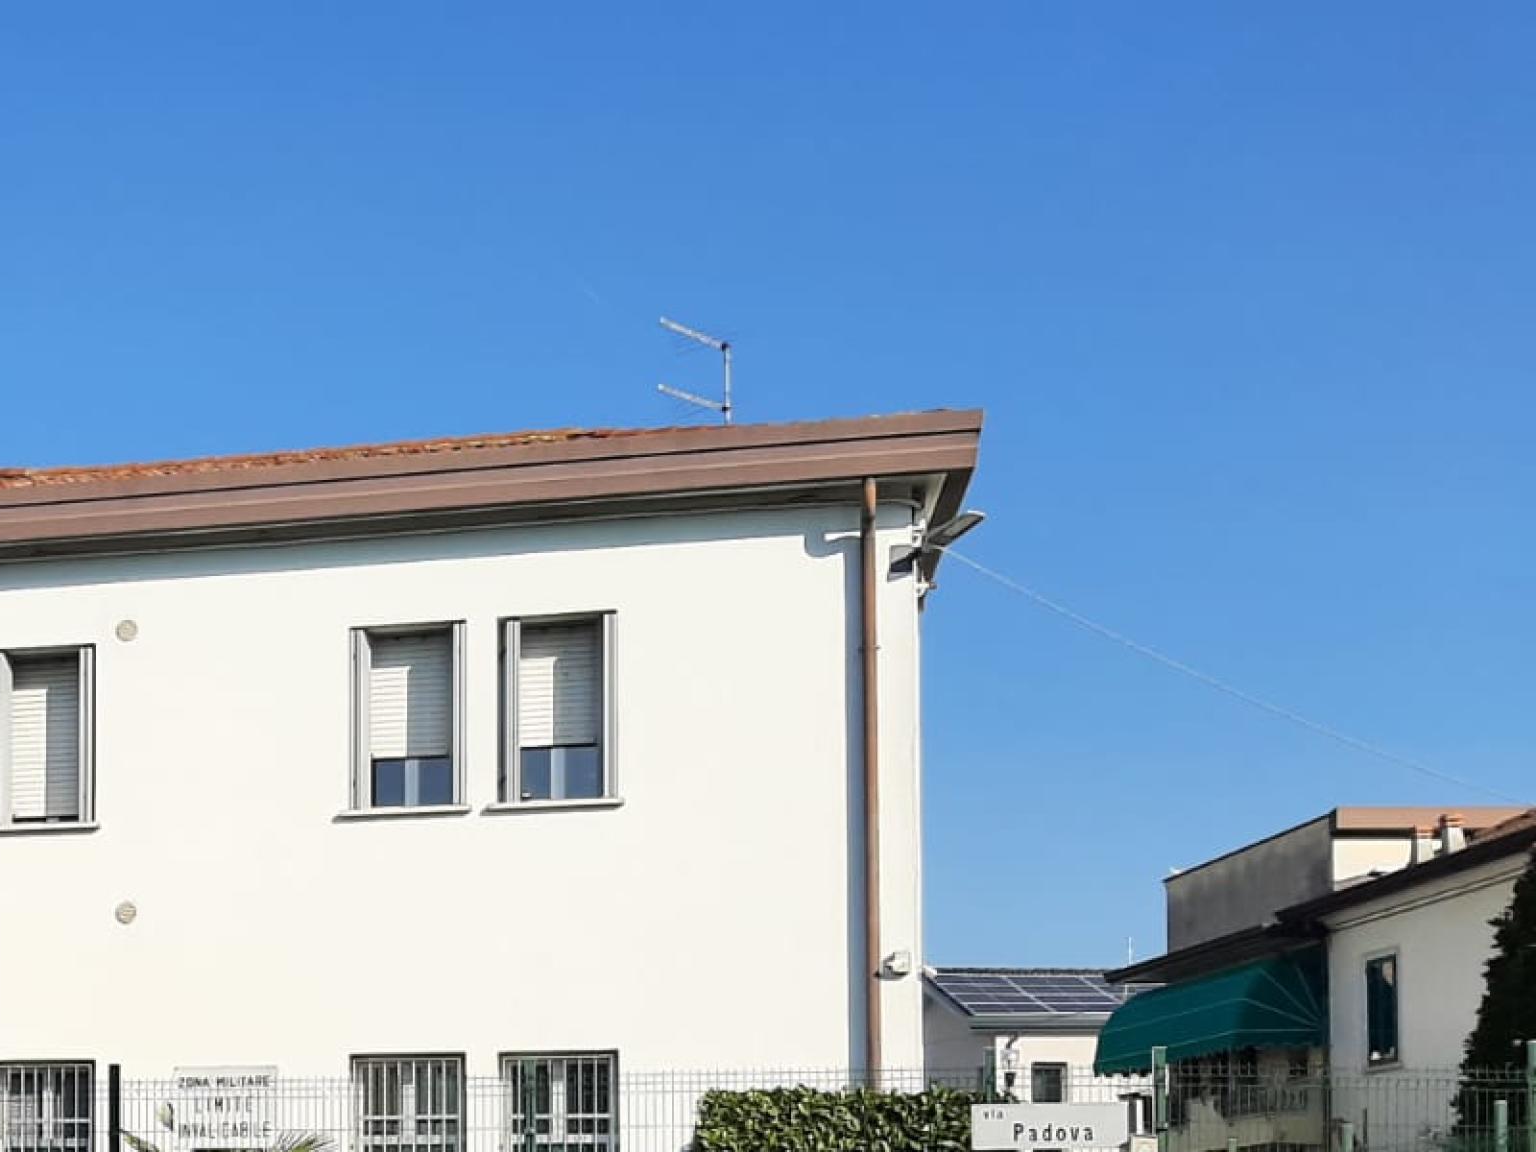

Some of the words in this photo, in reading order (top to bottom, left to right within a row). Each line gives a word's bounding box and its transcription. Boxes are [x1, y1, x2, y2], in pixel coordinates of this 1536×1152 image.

[178, 1076, 209, 1088] ZONA
[216, 1075, 270, 1088] MILITARE
[194, 1096, 253, 1113] LIMITE
[1013, 1122, 1094, 1142] Padova
